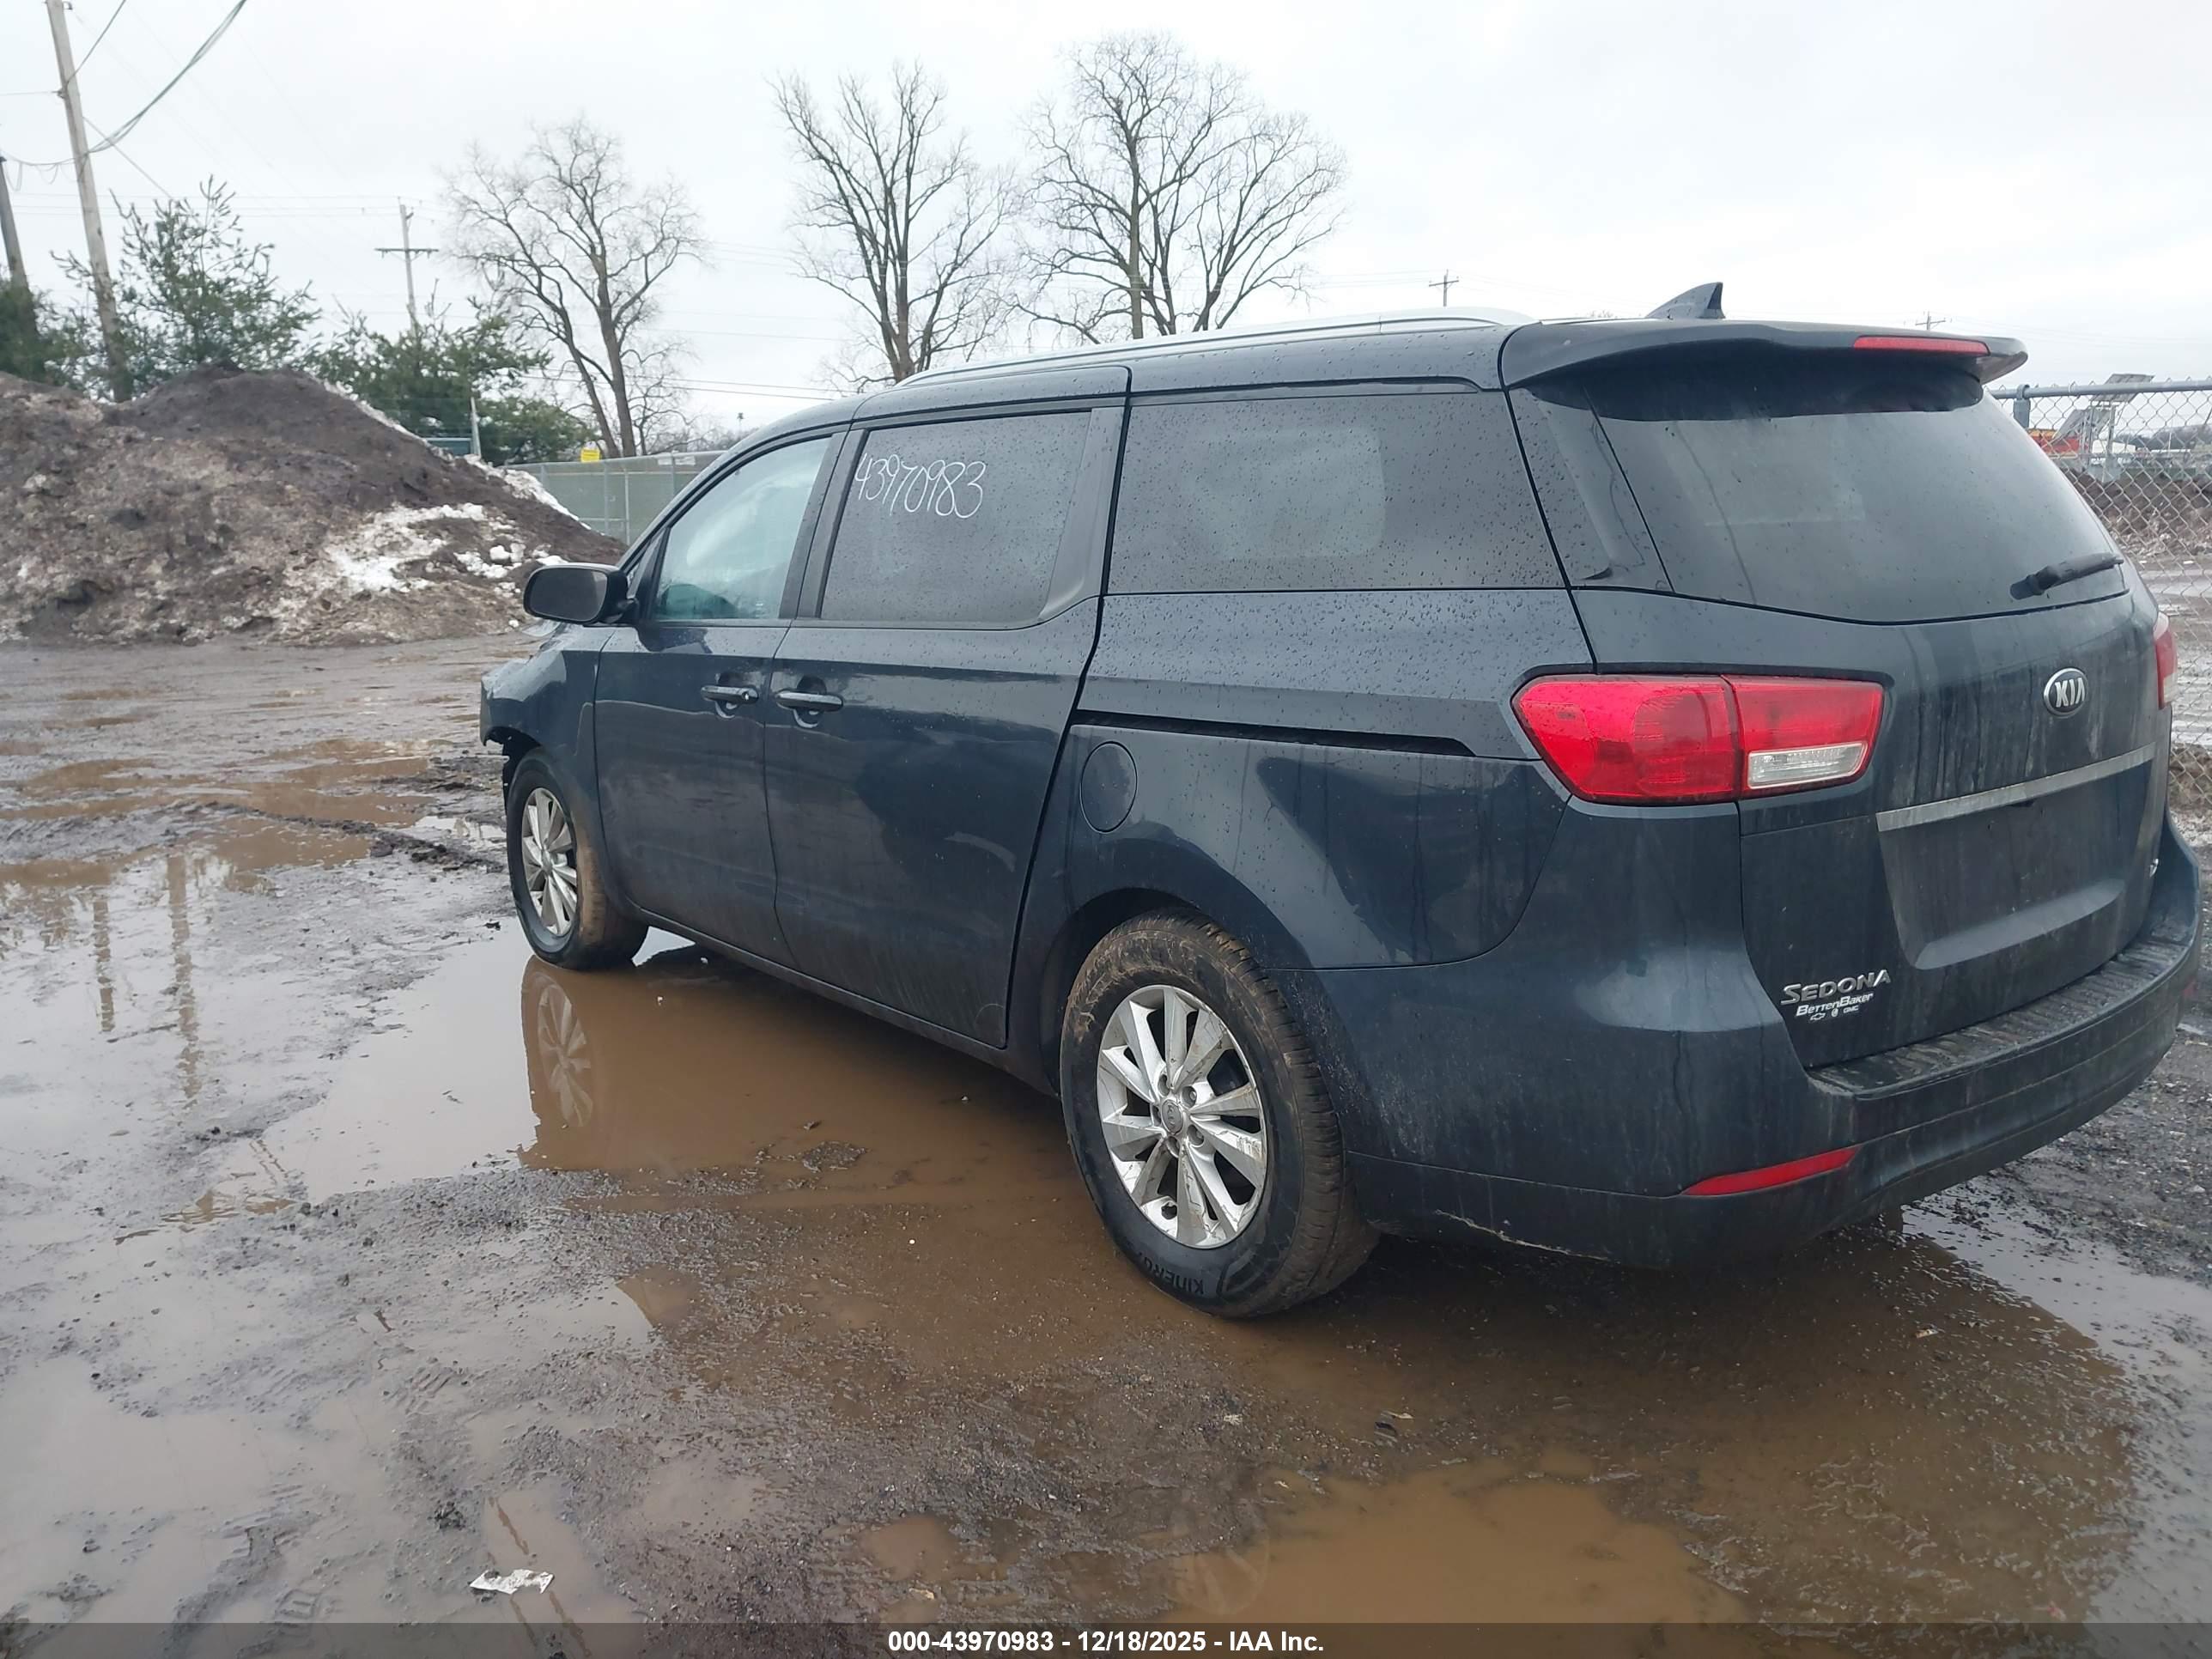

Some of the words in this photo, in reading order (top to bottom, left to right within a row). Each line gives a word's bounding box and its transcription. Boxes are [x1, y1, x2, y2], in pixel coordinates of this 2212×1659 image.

[854, 453, 987, 519] 43970983
[2054, 677, 2086, 708] KIA
[1780, 969, 1892, 1006] SEDONA
